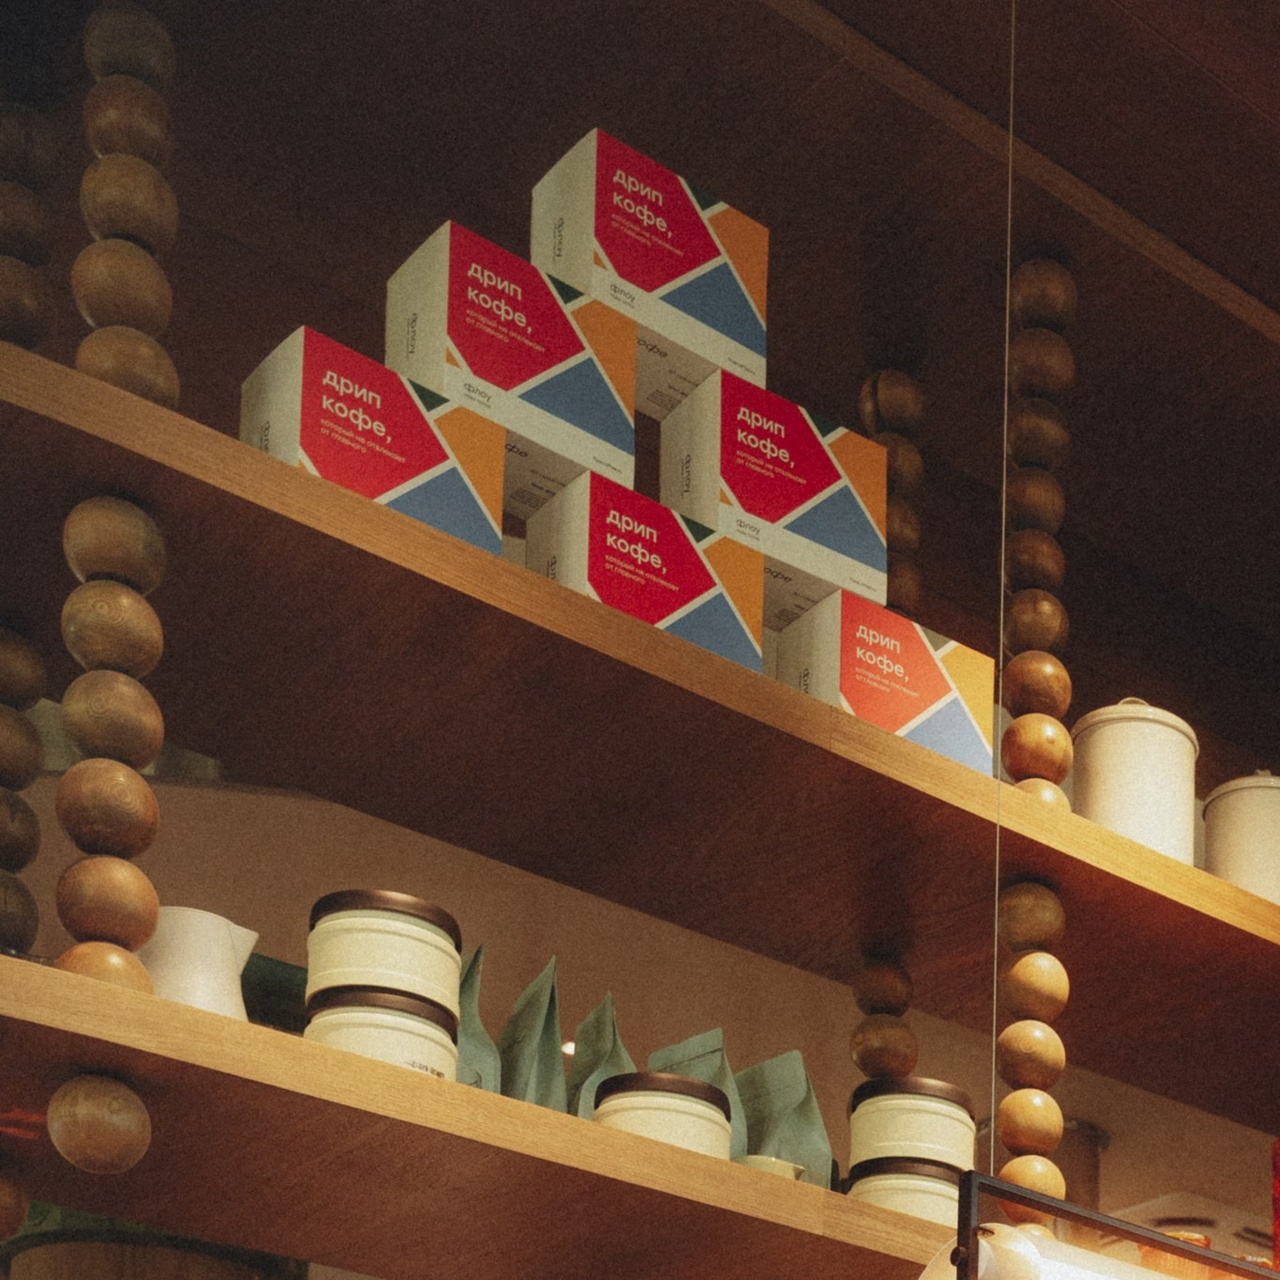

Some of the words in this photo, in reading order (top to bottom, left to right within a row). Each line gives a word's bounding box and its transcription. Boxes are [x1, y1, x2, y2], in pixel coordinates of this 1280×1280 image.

[613, 169, 663, 207] дрип
[613, 192, 673, 239] кофе,
[467, 262, 522, 301] дрип
[468, 286, 532, 334] кофе,
[637, 339, 668, 358] офе
[322, 370, 381, 410] дрип
[322, 395, 392, 444] кофе,
[737, 406, 785, 439] дрип
[737, 428, 795, 469] кофе,
[606, 509, 657, 543] дрип
[606, 532, 667, 575] кофе,
[856, 624, 901, 655] дрип
[856, 646, 909, 684] кофе,
